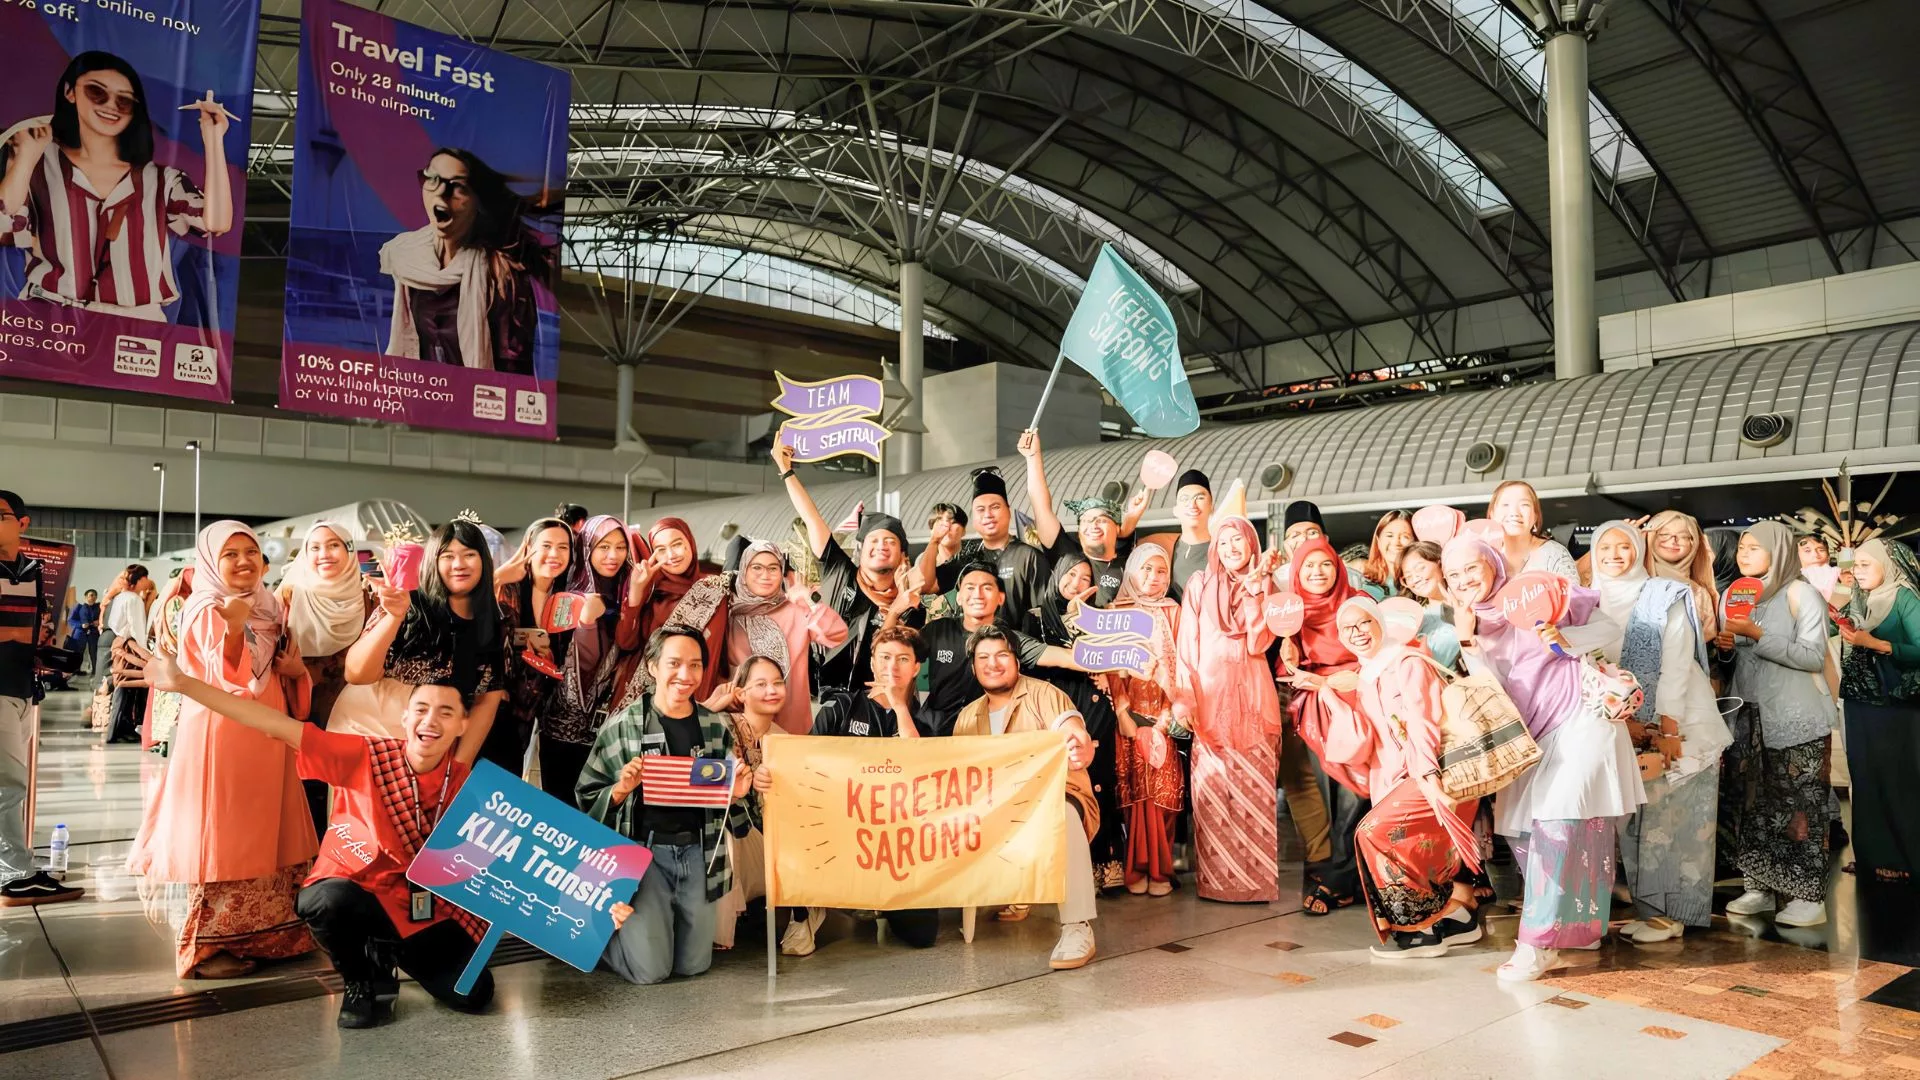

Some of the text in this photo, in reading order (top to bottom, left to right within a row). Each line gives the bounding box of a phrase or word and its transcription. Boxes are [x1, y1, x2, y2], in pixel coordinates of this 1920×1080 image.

[44, 3, 79, 22] off.
[163, 16, 200, 35] now
[331, 21, 495, 93] Travel Fast
[330, 61, 367, 86] Only
[371, 73, 391, 89] 28
[329, 81, 346, 95] to
[381, 97, 435, 121] airport.
[51, 323, 76, 336] on
[1106, 284, 1176, 361] KERETA
[117, 355, 155, 366] KLIA
[1089, 311, 1169, 382] SARONG
[298, 354, 334, 371] 10%
[339, 359, 374, 375] OFF
[429, 376, 448, 387] on
[295, 388, 311, 399] or
[808, 383, 850, 408] TEAM
[793, 427, 878, 455] KL SENTRAL
[1096, 613, 1131, 631] GENG
[1111, 648, 1141, 669] GENG
[847, 766, 993, 826] KERETAPI
[327, 823, 374, 865] AirAsia
[485, 791, 619, 876] Sooo easy with
[856, 814, 981, 881] SARONG
[457, 812, 613, 912] KLIA Transit
